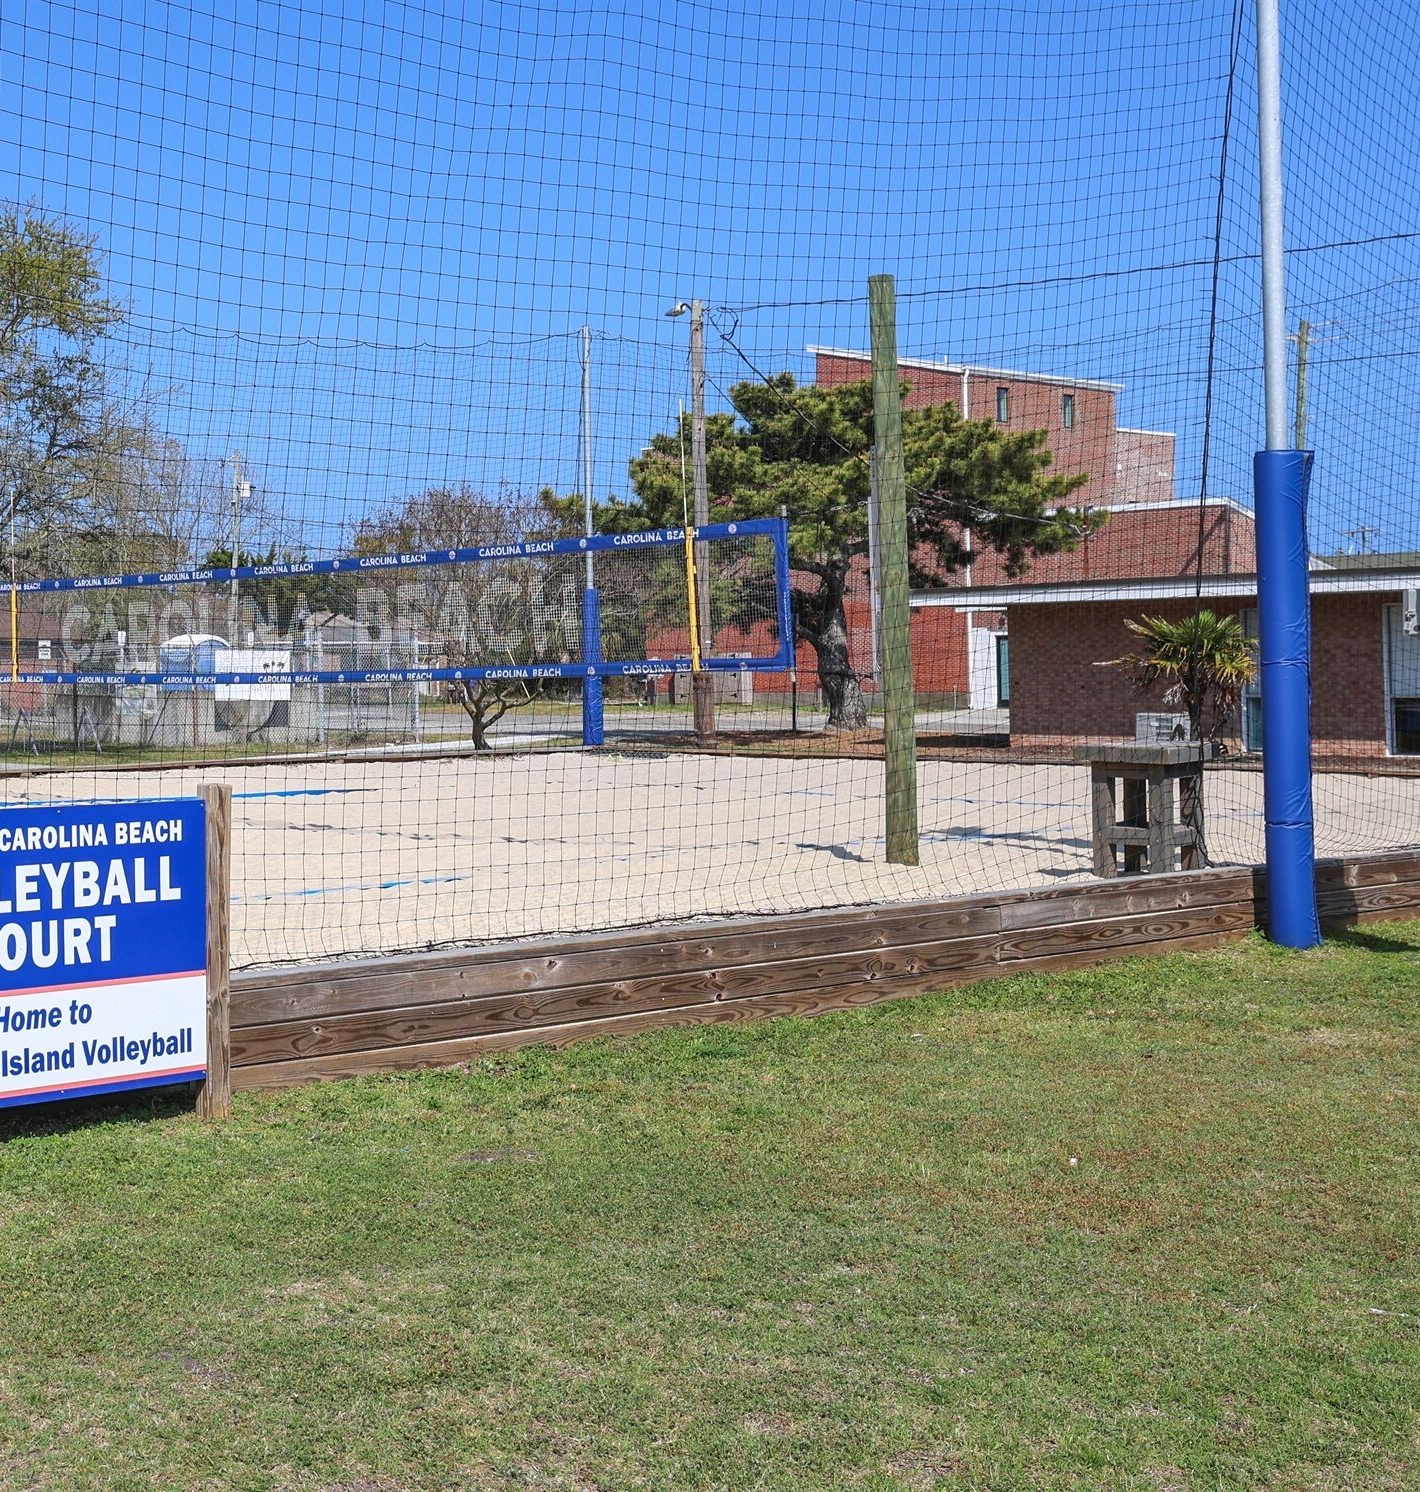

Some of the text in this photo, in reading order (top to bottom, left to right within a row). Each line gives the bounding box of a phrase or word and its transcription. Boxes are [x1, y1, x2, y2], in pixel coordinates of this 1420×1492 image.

[614, 528, 699, 546] CAROLINA BEAH
[479, 542, 554, 557] CAROLINA BEACH
[360, 554, 426, 566] CAROLINA BEACH
[254, 563, 314, 575] CAROLINA BEACH
[74, 577, 122, 587] CAROLINA BEACH
[159, 571, 212, 581] CAROLINA BEACH
[357, 574, 579, 654] BEACH
[485, 668, 562, 679] CAROLINA BEACH
[622, 665, 672, 674] CAROLINA
[77, 676, 104, 684] CAROLINA
[162, 676, 216, 684] CAROLINA BEACH
[365, 672, 432, 682] CAROLINA BEACH
[115, 819, 182, 844] BEACH
[70, 1000, 92, 1025] to
[1, 1043, 75, 1077] Island
[81, 1028, 192, 1066] Volleyball
